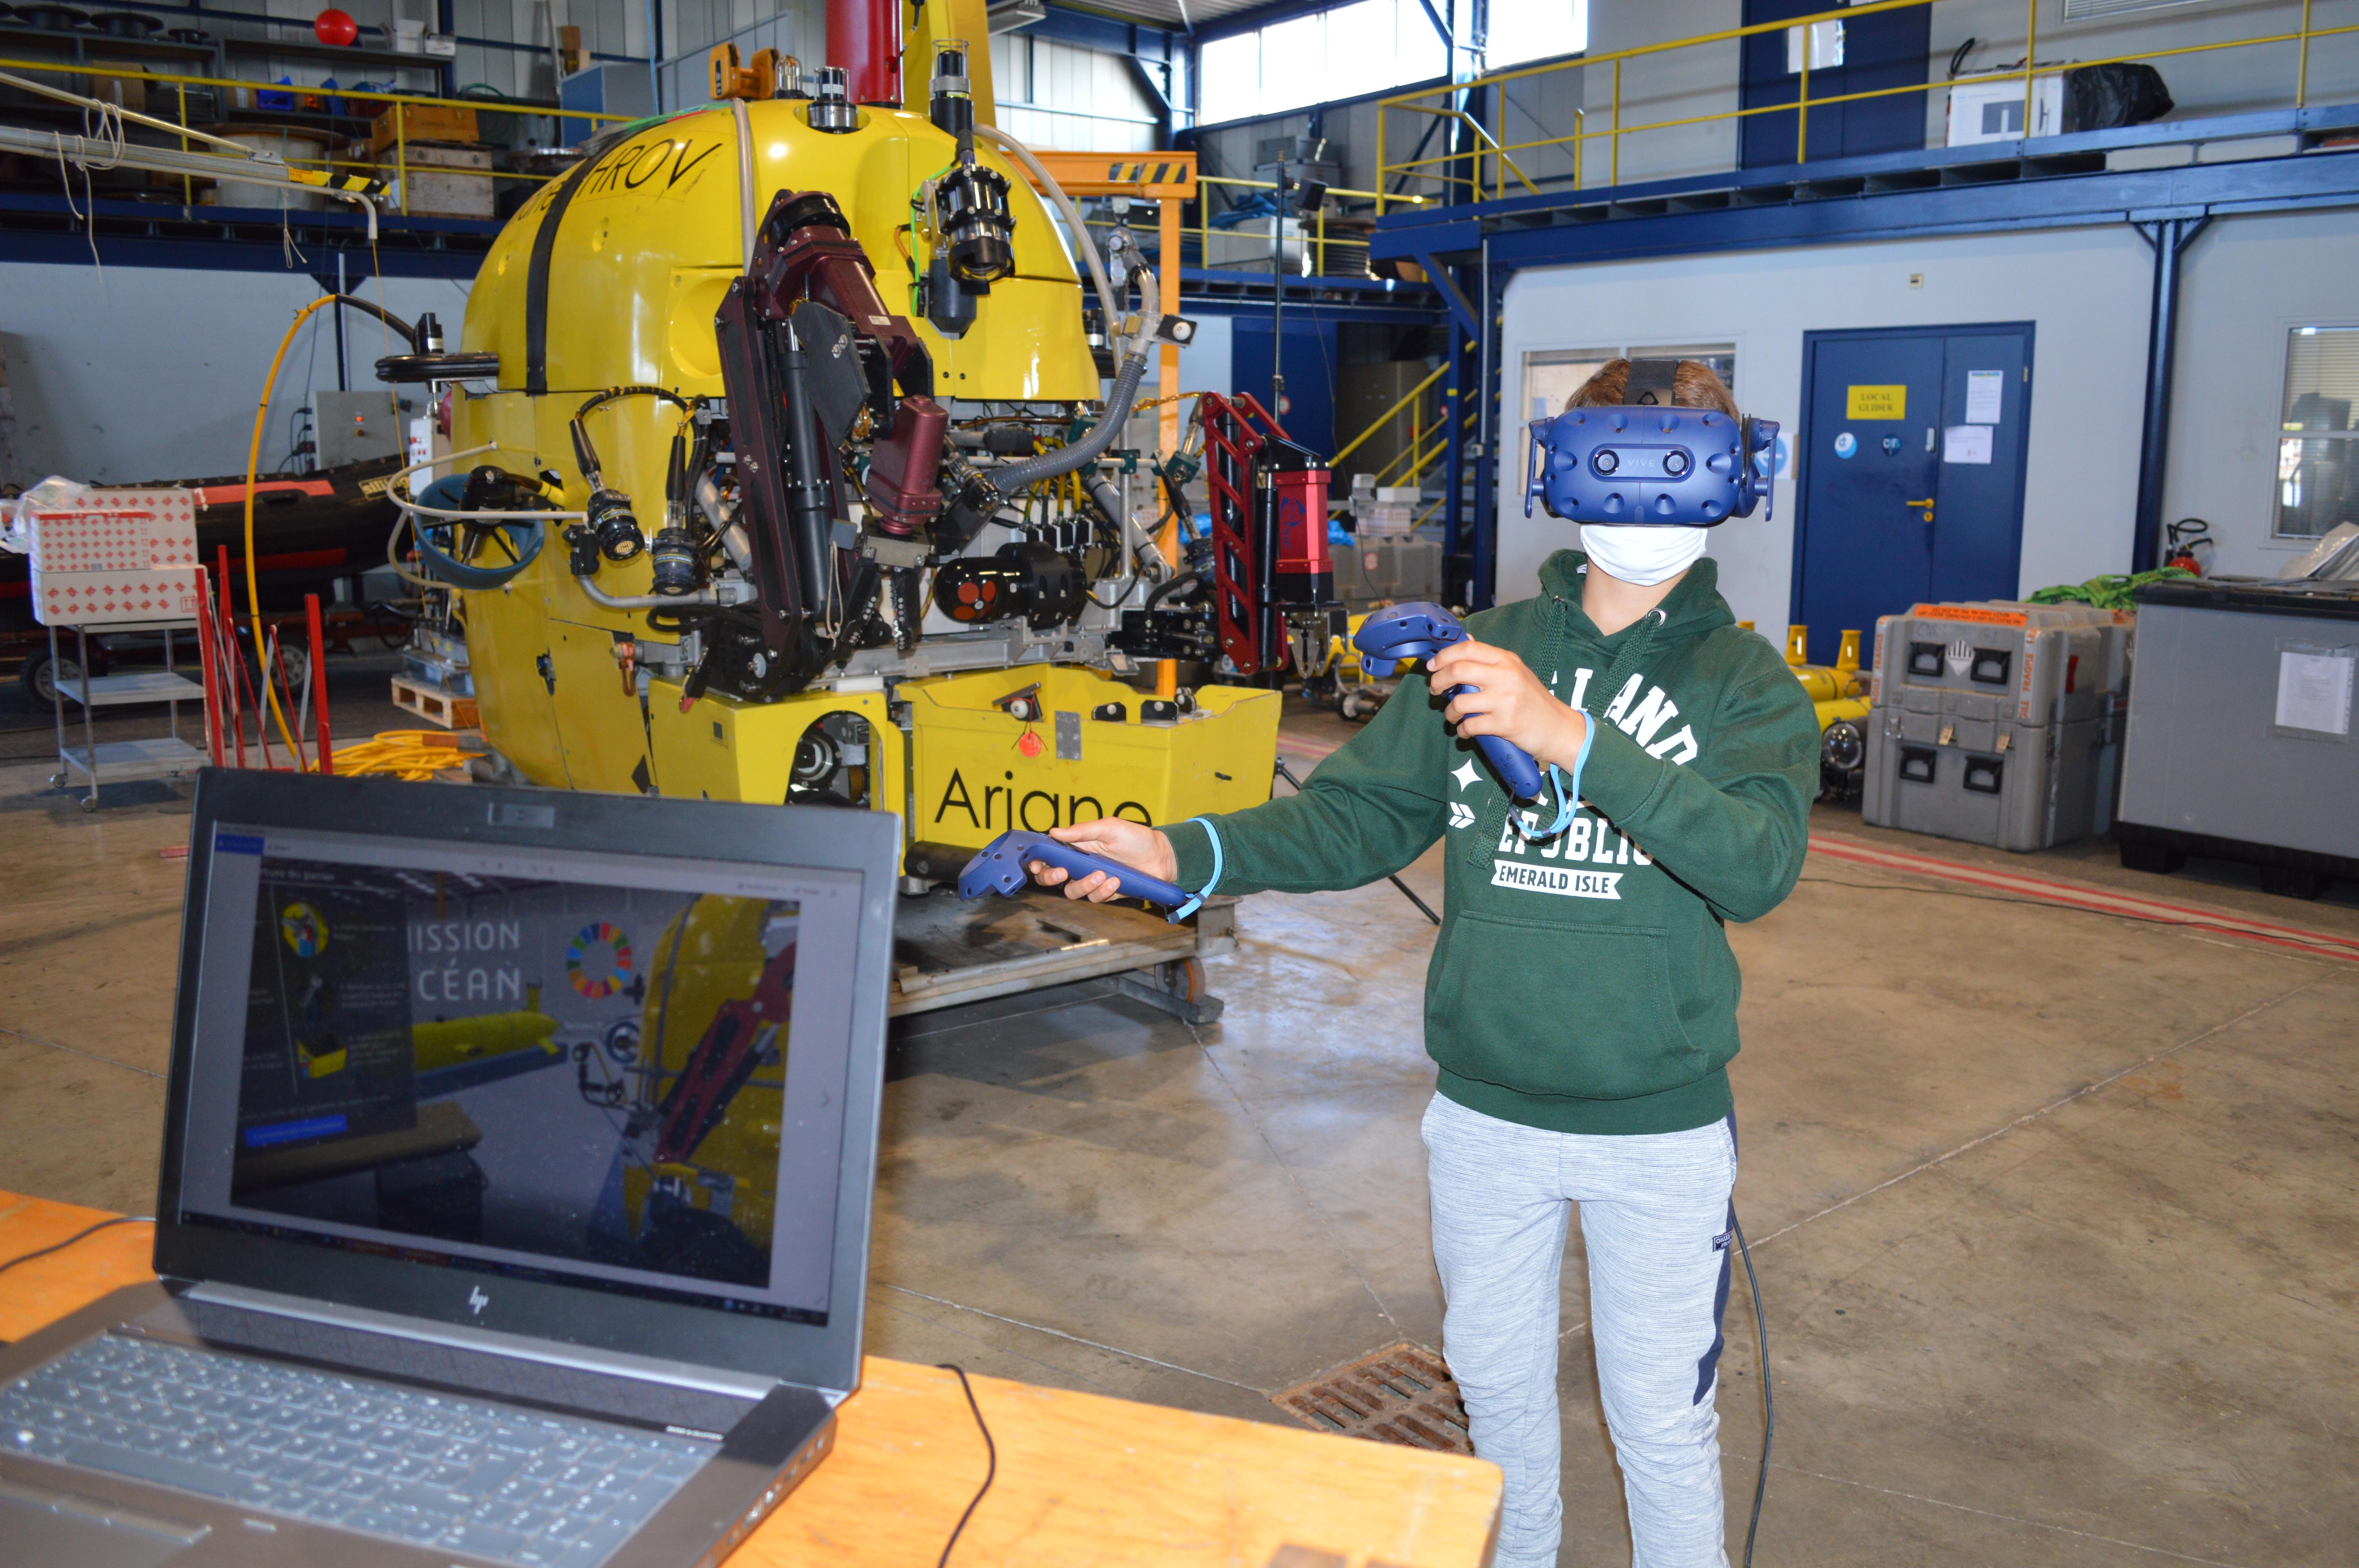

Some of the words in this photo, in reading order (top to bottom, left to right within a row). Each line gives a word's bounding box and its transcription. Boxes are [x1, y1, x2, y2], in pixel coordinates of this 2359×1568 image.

[577, 138, 723, 197] HROV
[1858, 403, 1893, 411] GLIDER
[1874, 633, 1884, 670] FRAGILE
[2022, 653, 2034, 692] FRAGILE
[1549, 668, 1698, 766] LAND
[934, 768, 1152, 830] Ariane
[1499, 866, 1568, 890] EMERALD
[1575, 875, 1610, 893] ISLE
[470, 1285, 489, 1314] hp
